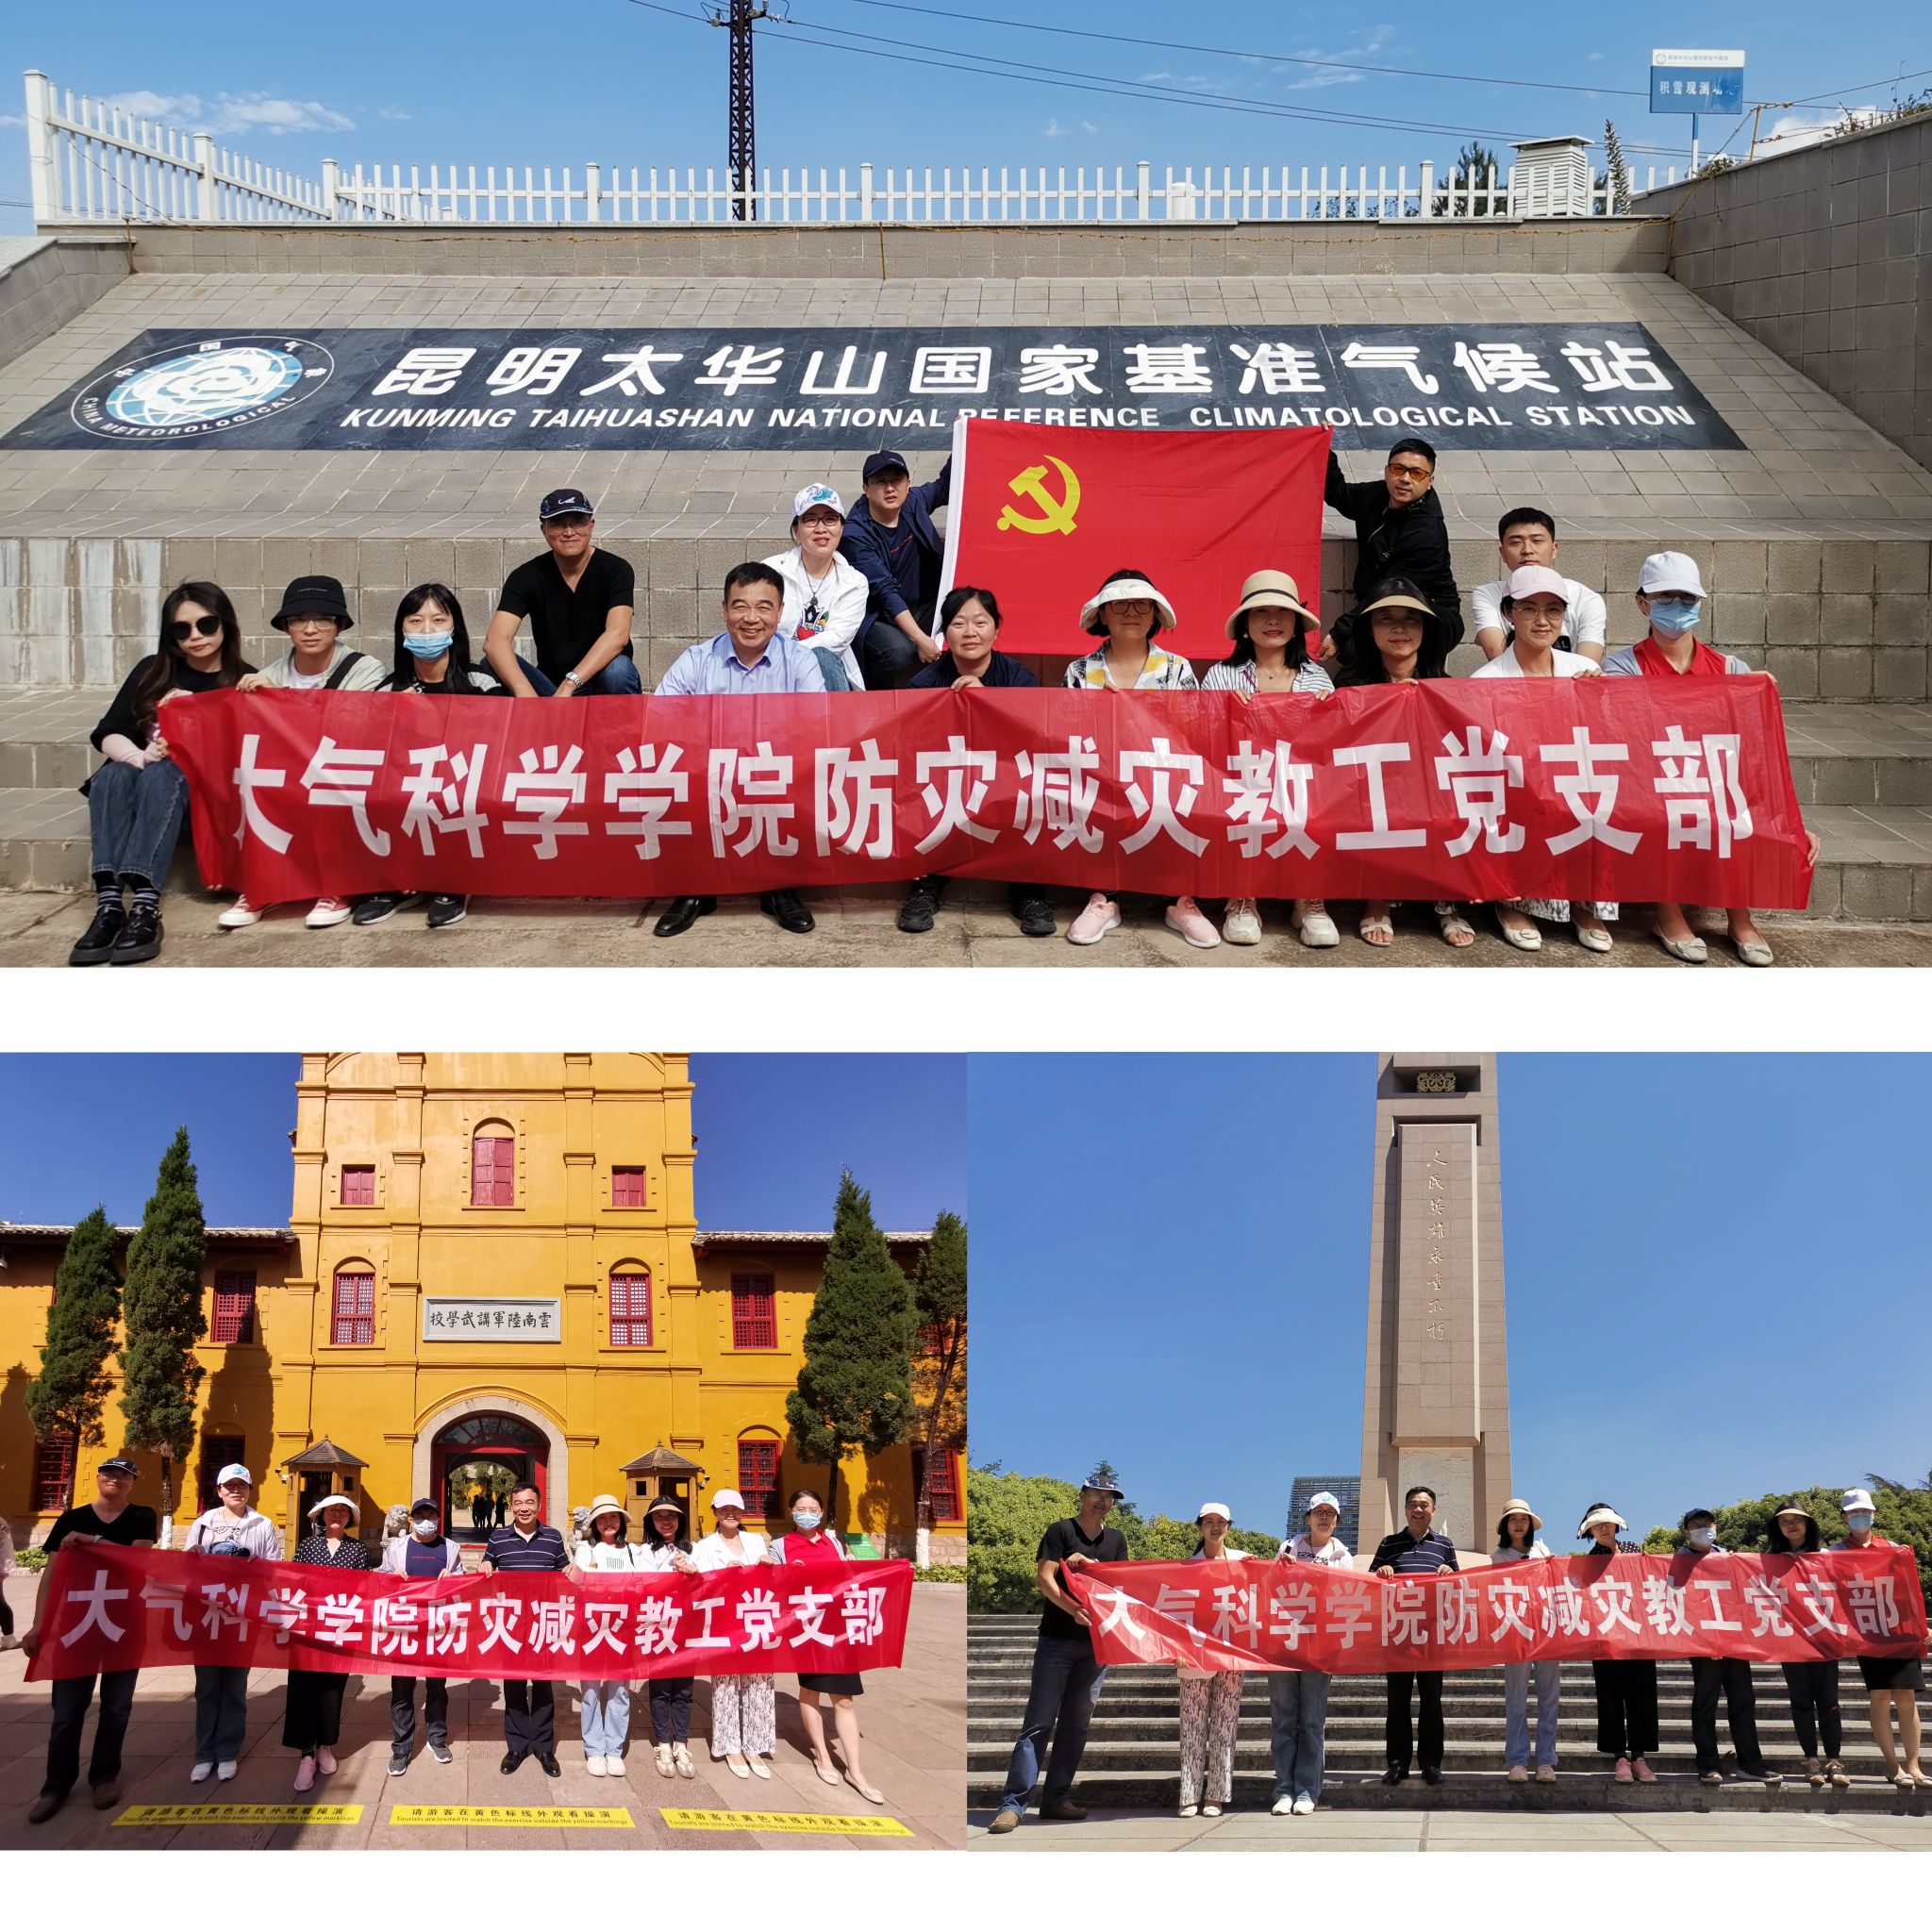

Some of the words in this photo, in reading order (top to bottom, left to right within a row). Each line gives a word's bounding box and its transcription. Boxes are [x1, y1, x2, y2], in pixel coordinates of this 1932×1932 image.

[371, 341, 1674, 396] 昆明太华山国家基准气候站
[83, 397, 104, 425] CHINA
[99, 395, 296, 437] METEOROLOGICAL
[340, 408, 517, 428] KUNMING
[528, 408, 755, 428] TAIHUASHAN
[767, 408, 946, 428] NATIONAL
[1190, 407, 1514, 427] CLIMATOLOGICAL
[1524, 406, 1696, 426] STATION
[232, 725, 1753, 860] 大气科学学院防灾减灾教工党支部
[60, 1569, 888, 1657] 大气科学学院防灾减灾教工党支部
[1096, 1573, 1900, 1652] 大气科学学院防灾减灾教工党支部
